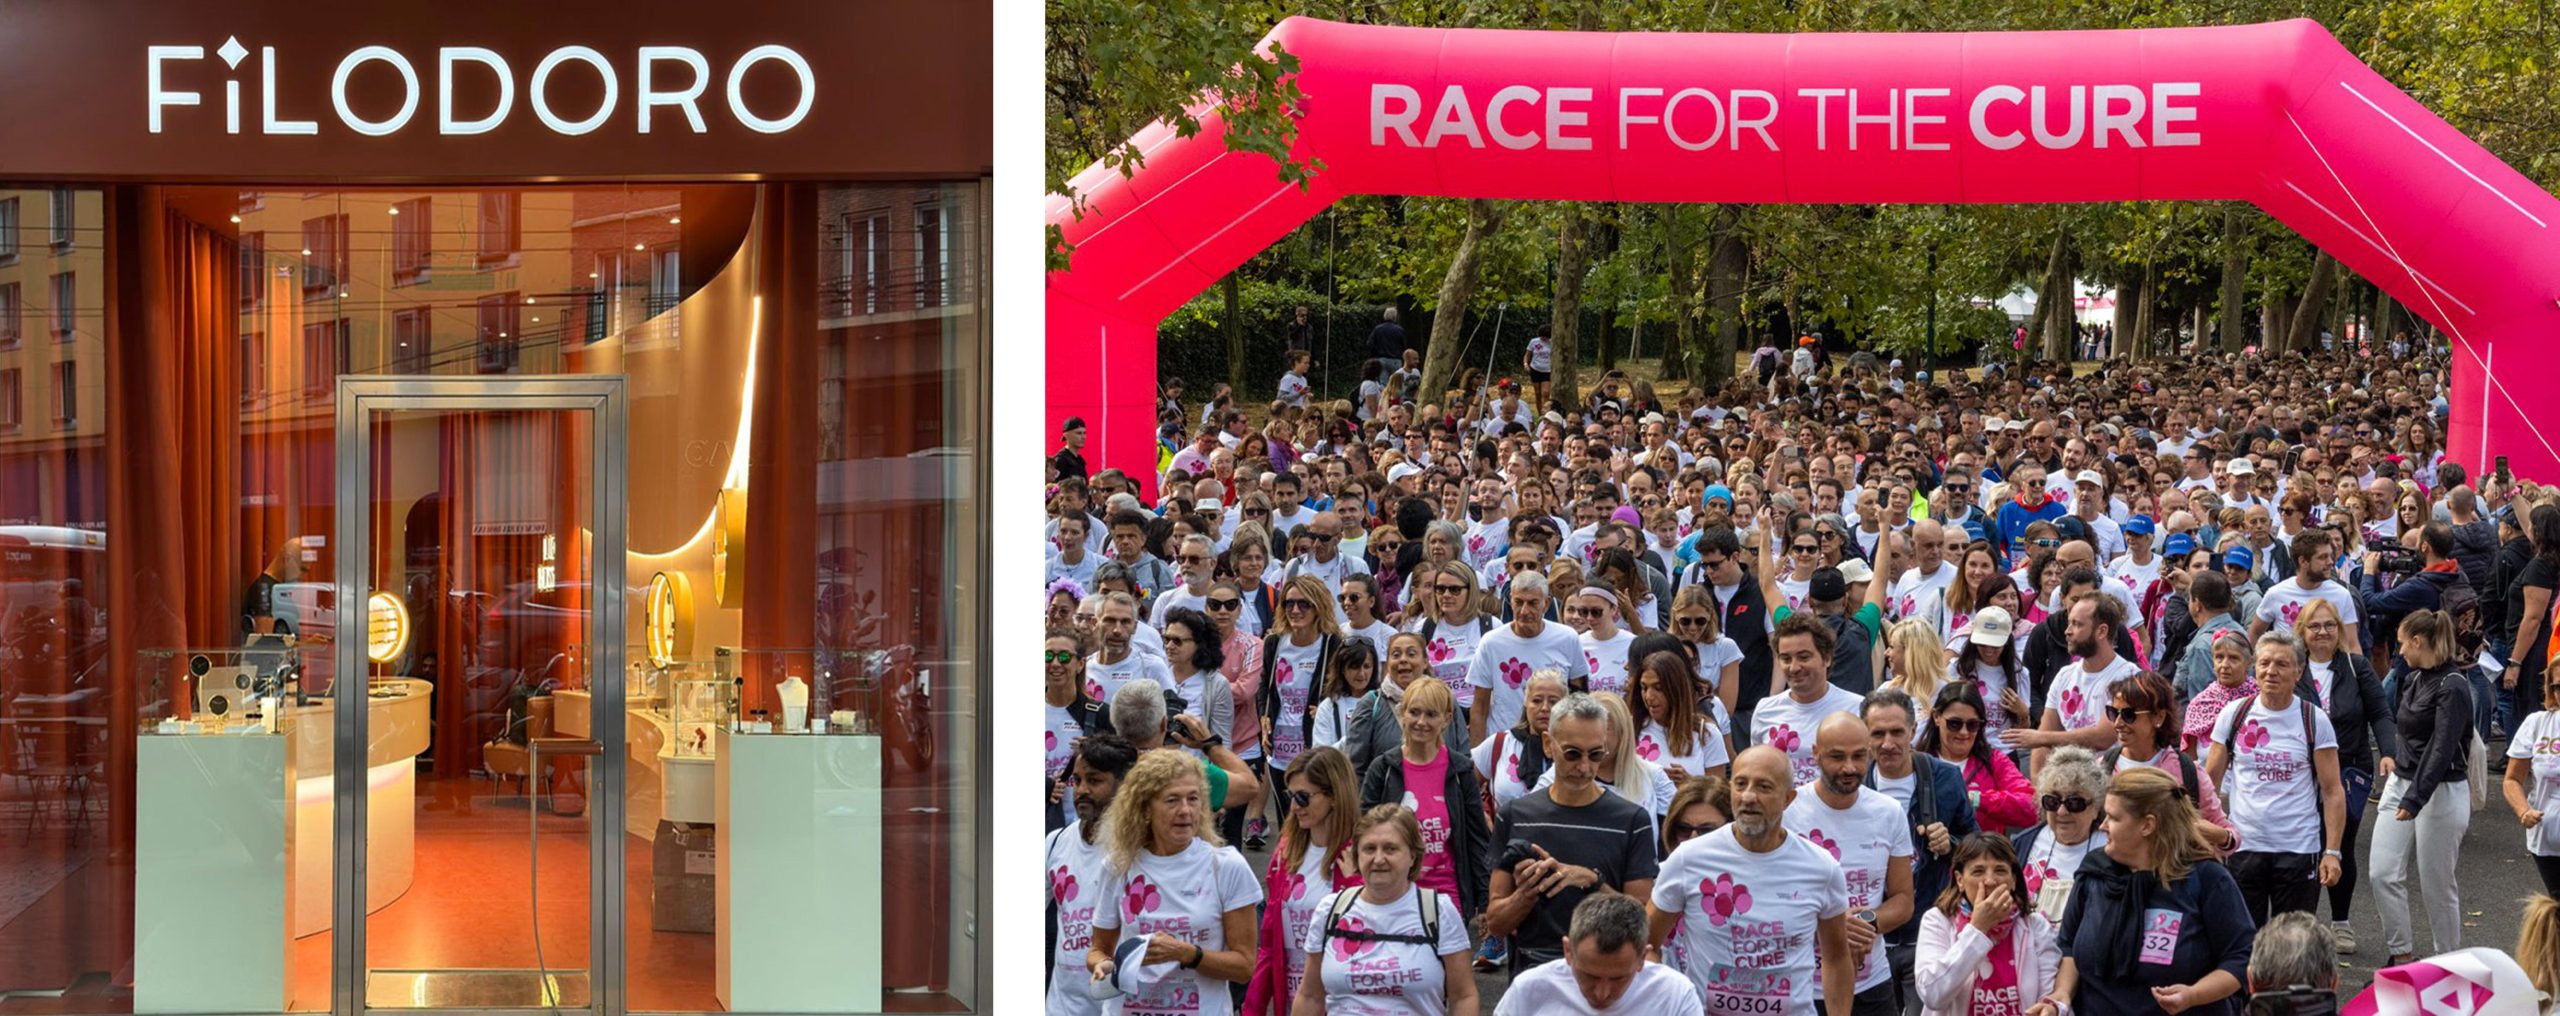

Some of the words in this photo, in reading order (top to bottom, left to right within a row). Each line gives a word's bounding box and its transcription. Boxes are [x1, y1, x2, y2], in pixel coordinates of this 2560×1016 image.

[1369, 83, 1593, 151] RACE
[1620, 88, 1780, 152] FOR
[1798, 88, 1951, 152] THE
[1969, 82, 2200, 149] CURE
[2255, 752, 2292, 763] RACE
[2258, 770, 2292, 782] CURE
[1858, 879, 1881, 893] THE
[1064, 923, 1086, 938] FOR
[1139, 916, 1191, 934] RACE
[1731, 920, 1784, 939] RACE
[1733, 940, 1769, 954] FOR
[1773, 933, 1803, 949] THE
[2146, 935, 2170, 952] 32
[1735, 951, 1786, 968] CURE
[1350, 972, 1386, 988] FOR
[1392, 968, 1423, 984] THE
[1974, 986, 2018, 1003] RACE
[1714, 994, 1782, 1014] 30304
